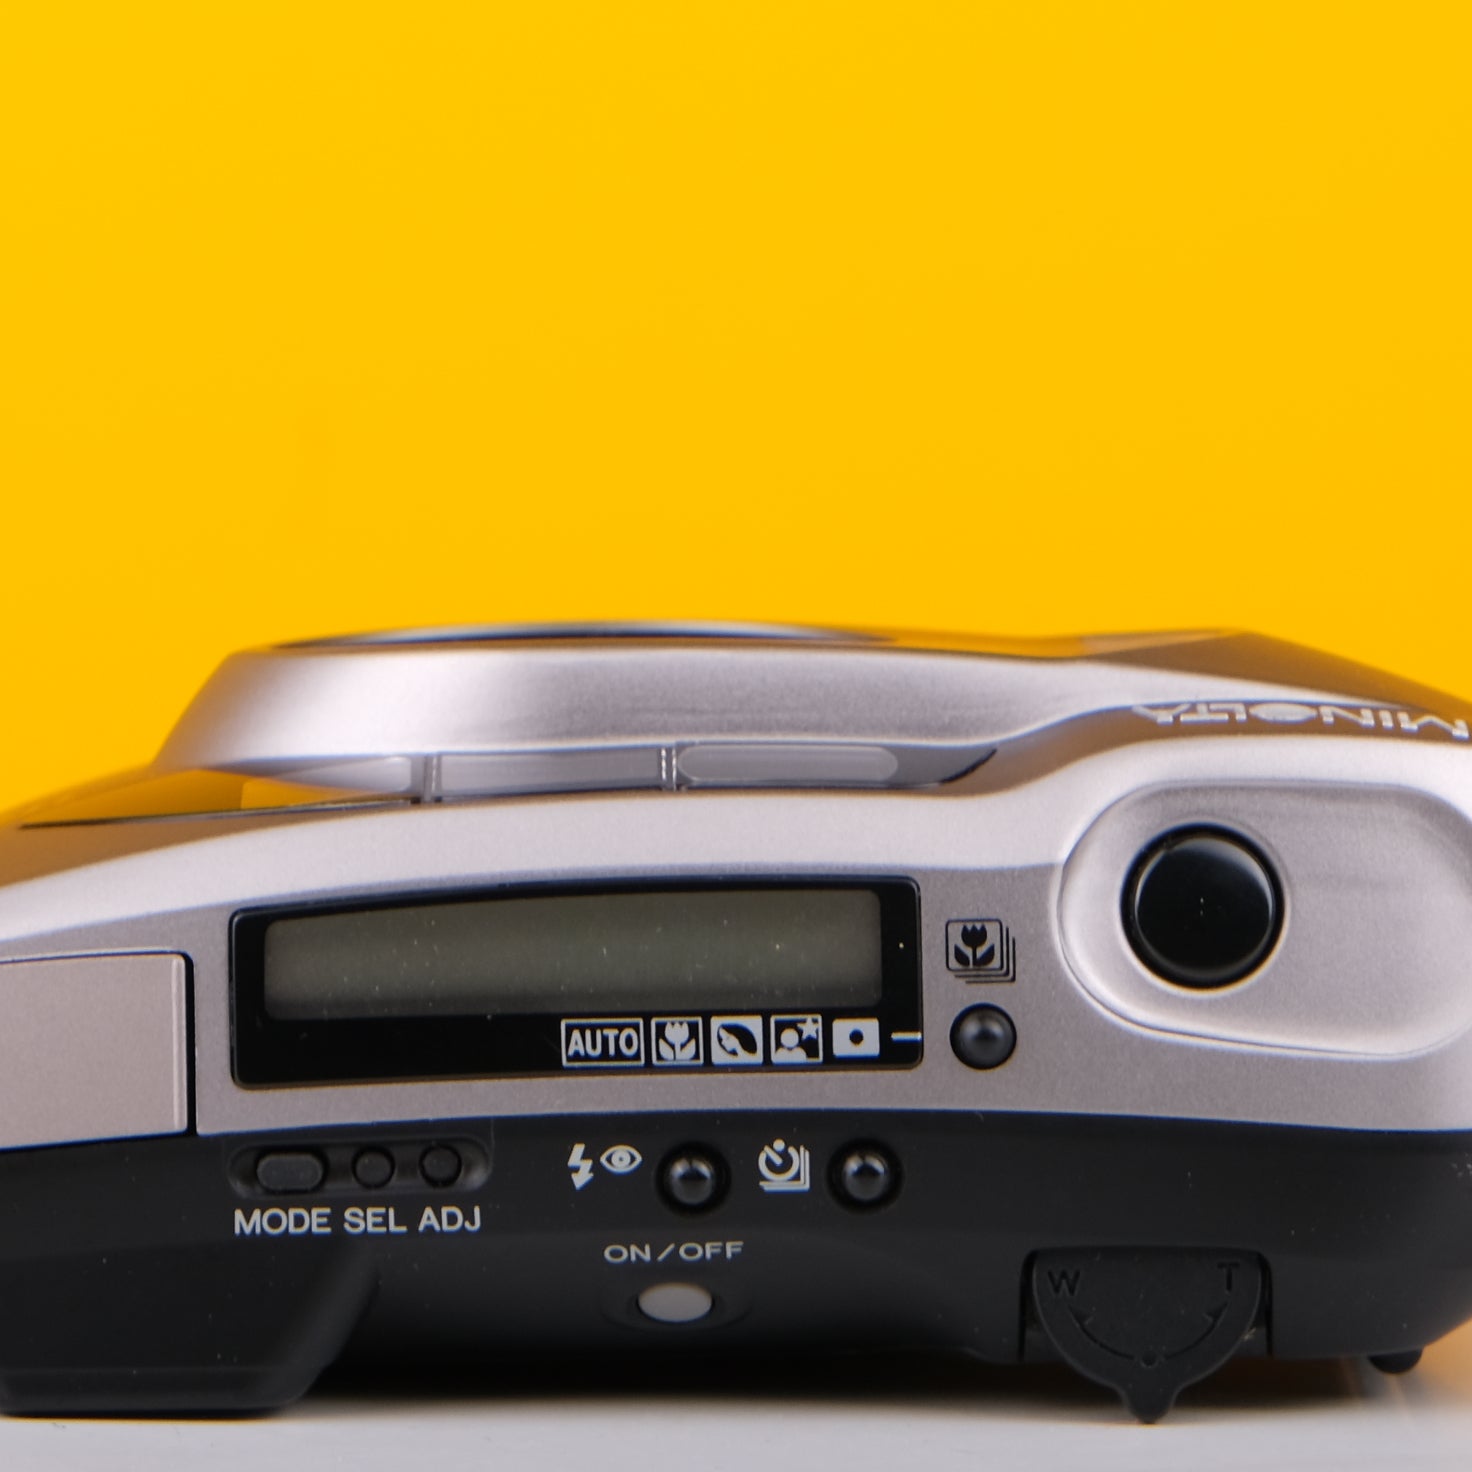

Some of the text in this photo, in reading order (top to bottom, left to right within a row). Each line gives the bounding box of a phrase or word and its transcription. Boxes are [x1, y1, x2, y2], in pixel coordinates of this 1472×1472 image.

[1131, 702, 1470, 738] MINOLTA
[567, 1028, 639, 1057] AUTO
[234, 1205, 481, 1235] MODE SEL ADJ
[603, 1240, 744, 1263] ON/OFF
[1047, 1269, 1080, 1296] W
[1217, 1262, 1240, 1292] T
